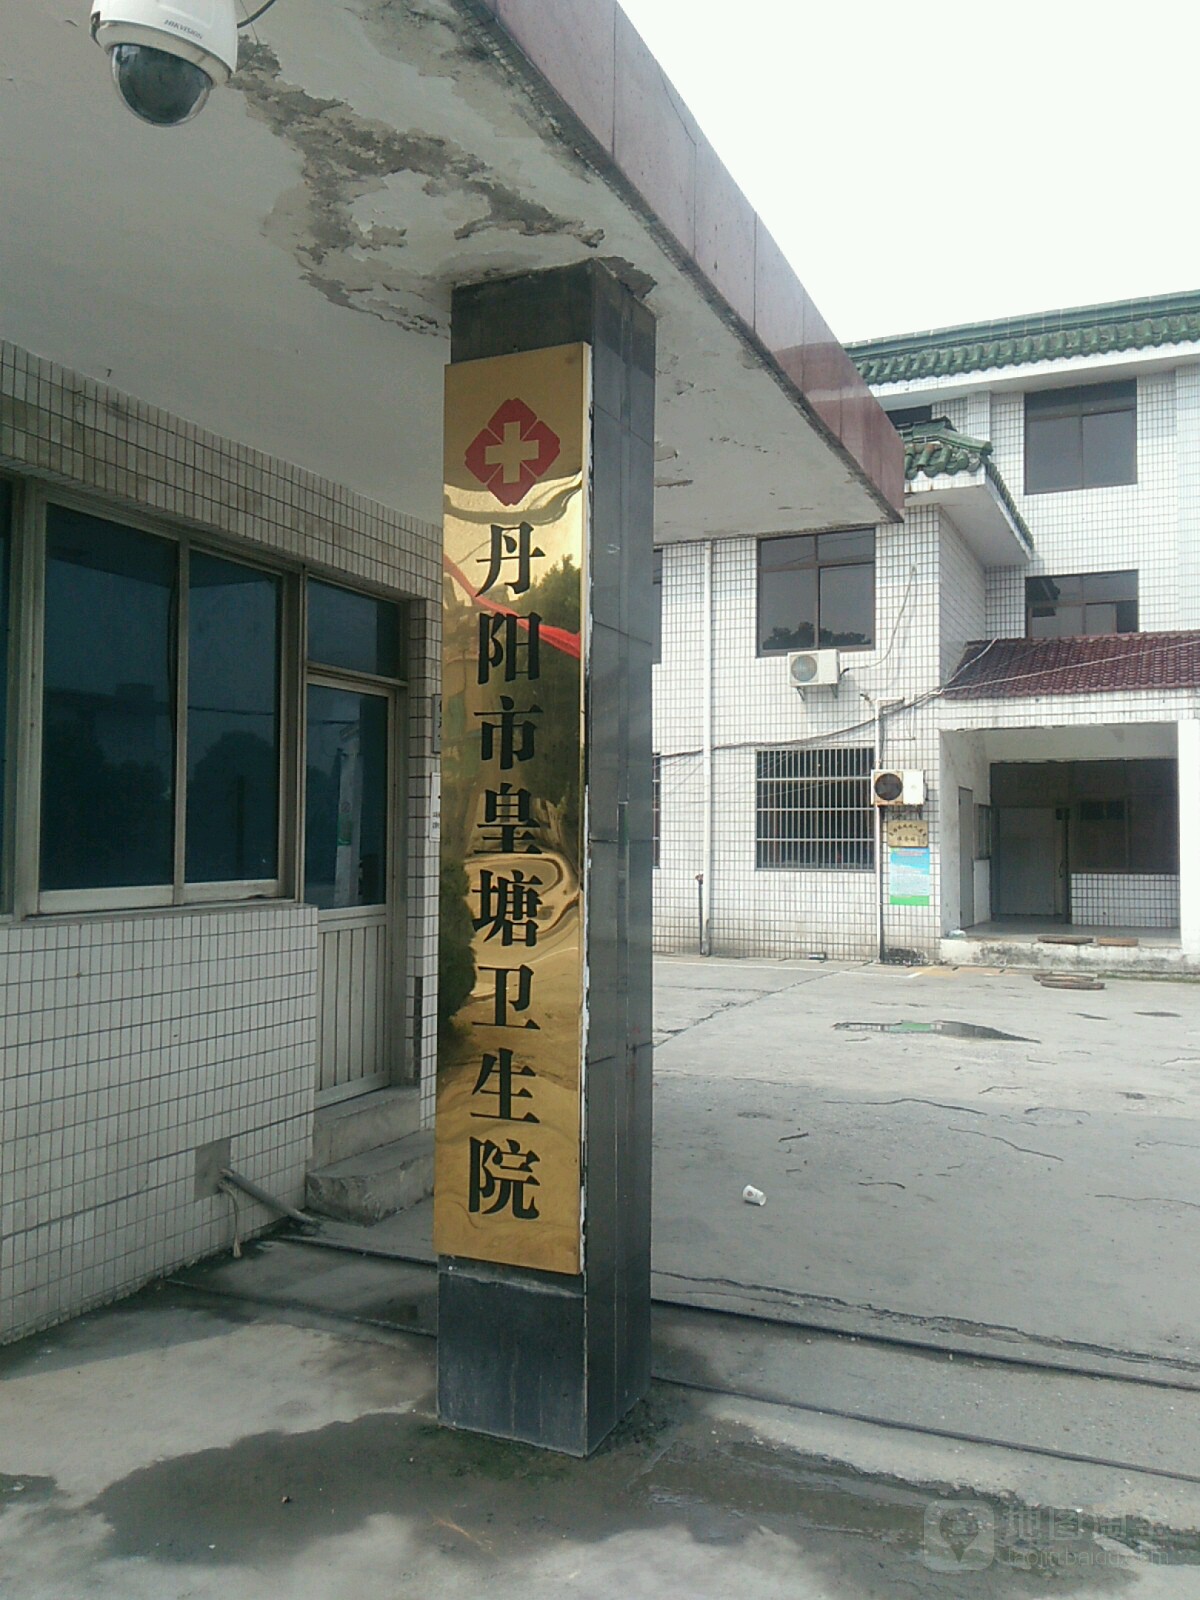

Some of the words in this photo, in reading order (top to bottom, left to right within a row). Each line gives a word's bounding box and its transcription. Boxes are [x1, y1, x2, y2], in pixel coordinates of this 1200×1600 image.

[164, 19, 203, 39] HIKVISION
[468, 521, 546, 1220] 丹阳市皇塘卫生院
